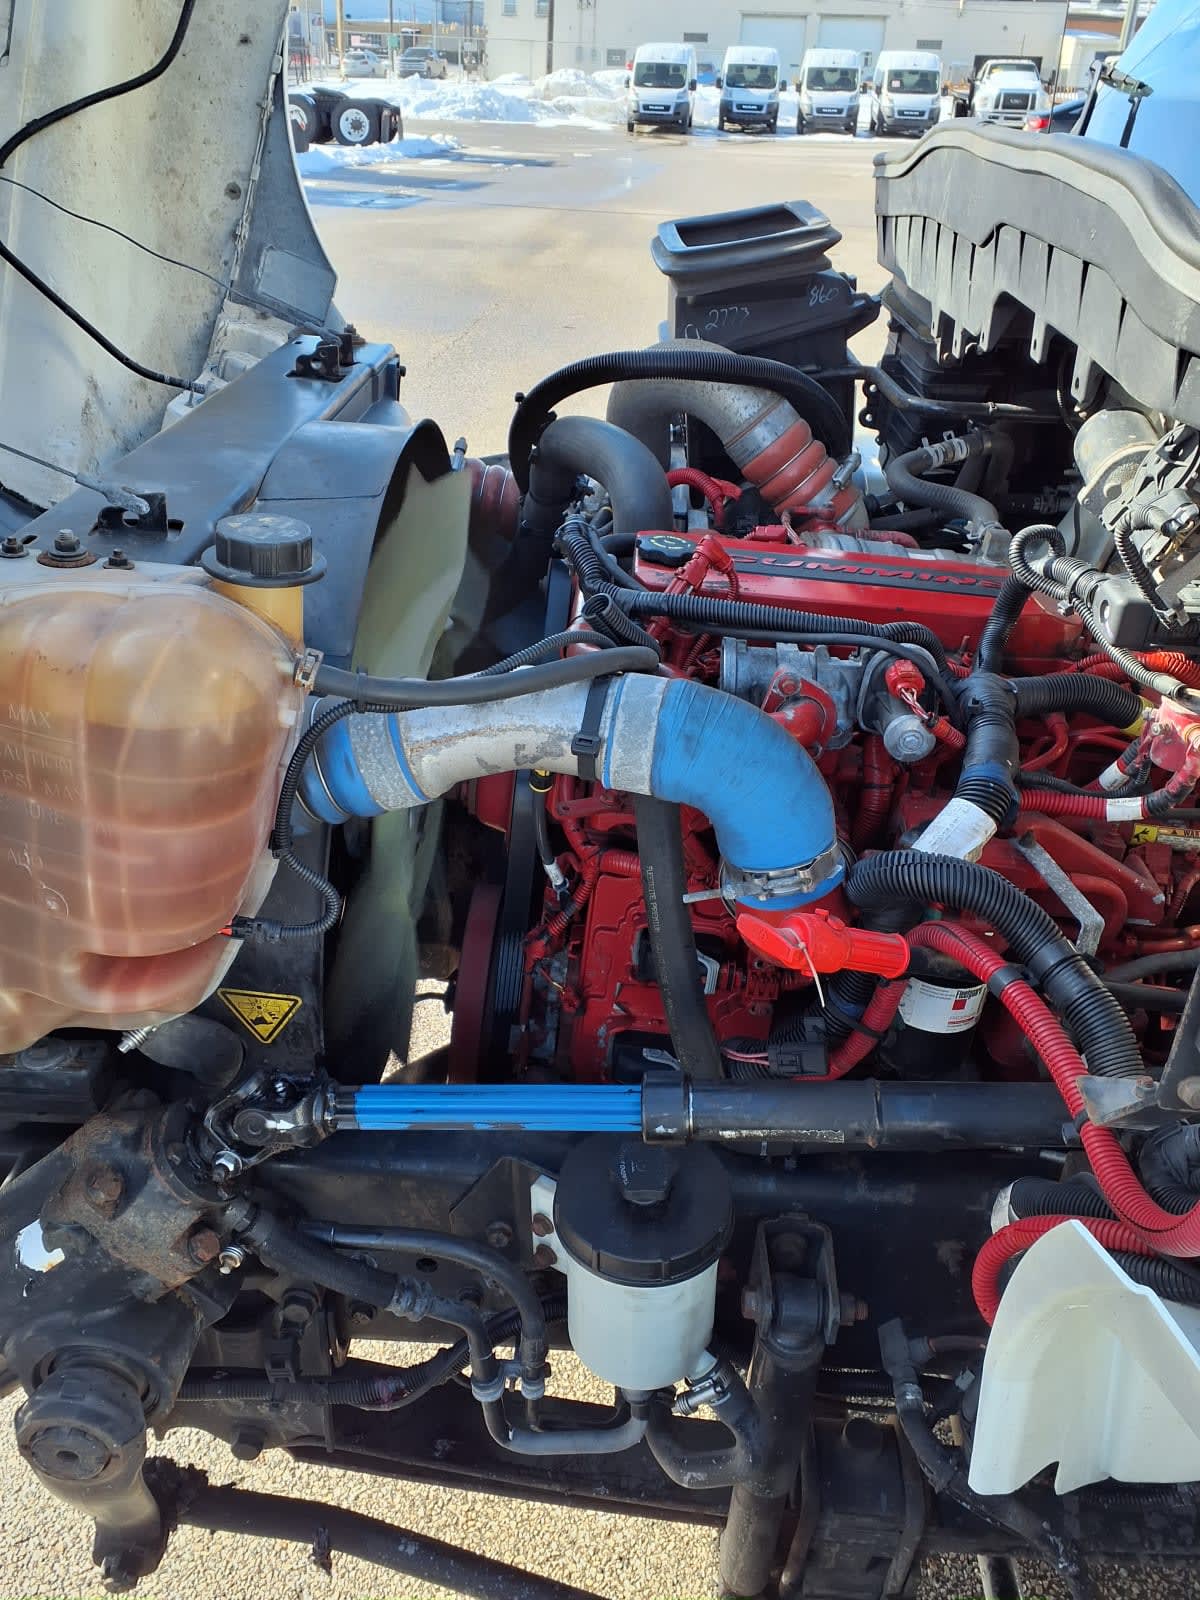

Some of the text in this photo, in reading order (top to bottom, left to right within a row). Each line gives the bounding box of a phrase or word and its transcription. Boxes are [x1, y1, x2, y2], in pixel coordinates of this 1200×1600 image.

[704, 306, 750, 330] 2773
[730, 554, 1003, 589] CUMMINS
[8, 703, 51, 729] MAX
